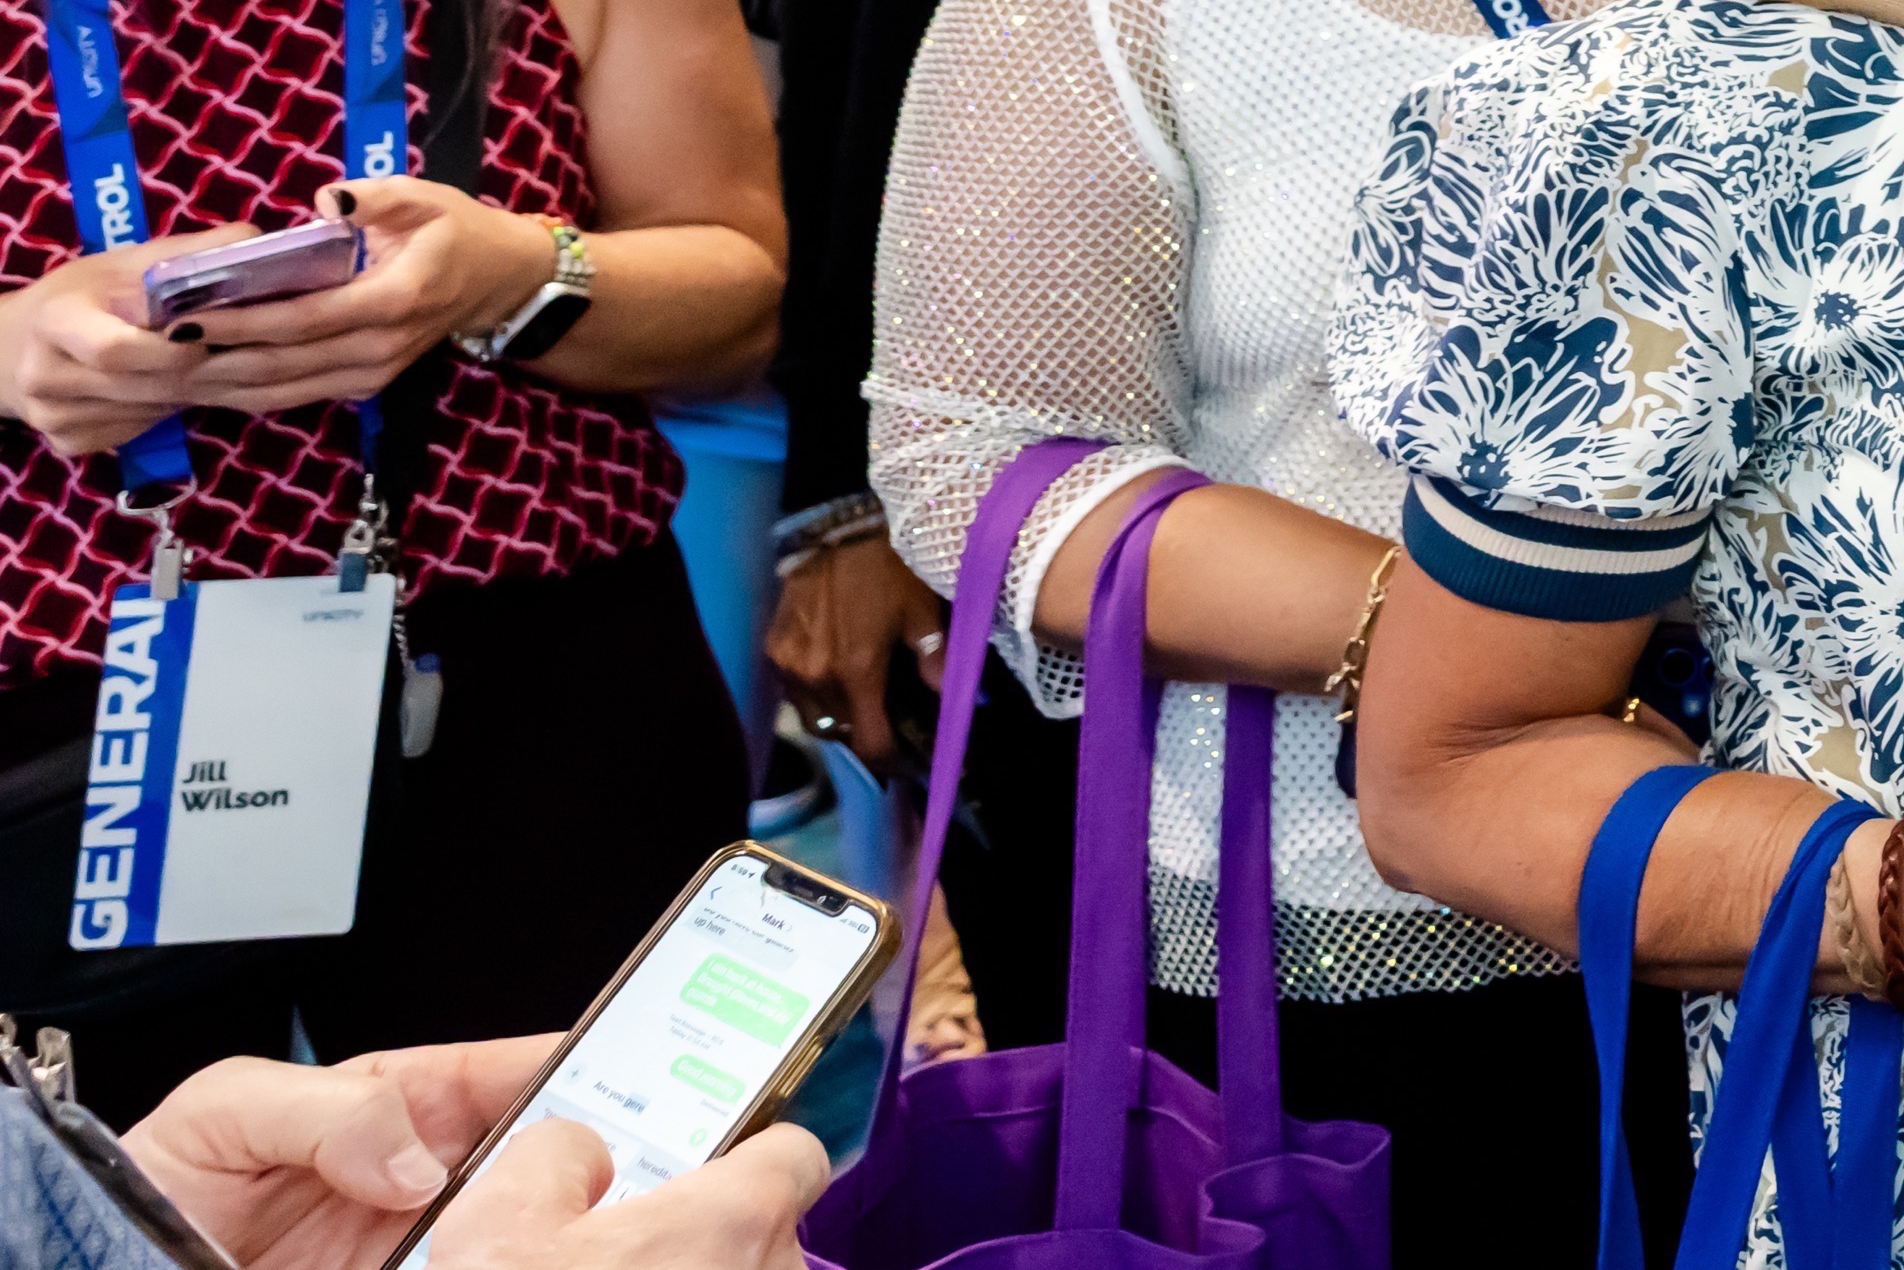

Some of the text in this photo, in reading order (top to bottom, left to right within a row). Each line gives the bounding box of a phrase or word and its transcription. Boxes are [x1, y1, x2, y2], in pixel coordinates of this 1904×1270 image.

[182, 760, 227, 784] Jill
[181, 788, 290, 812] Wilson
[693, 916, 706, 929] up
[707, 919, 726, 937] here
[761, 912, 786, 931] Mark
[593, 1080, 610, 1094] Are
[609, 1086, 626, 1103] you
